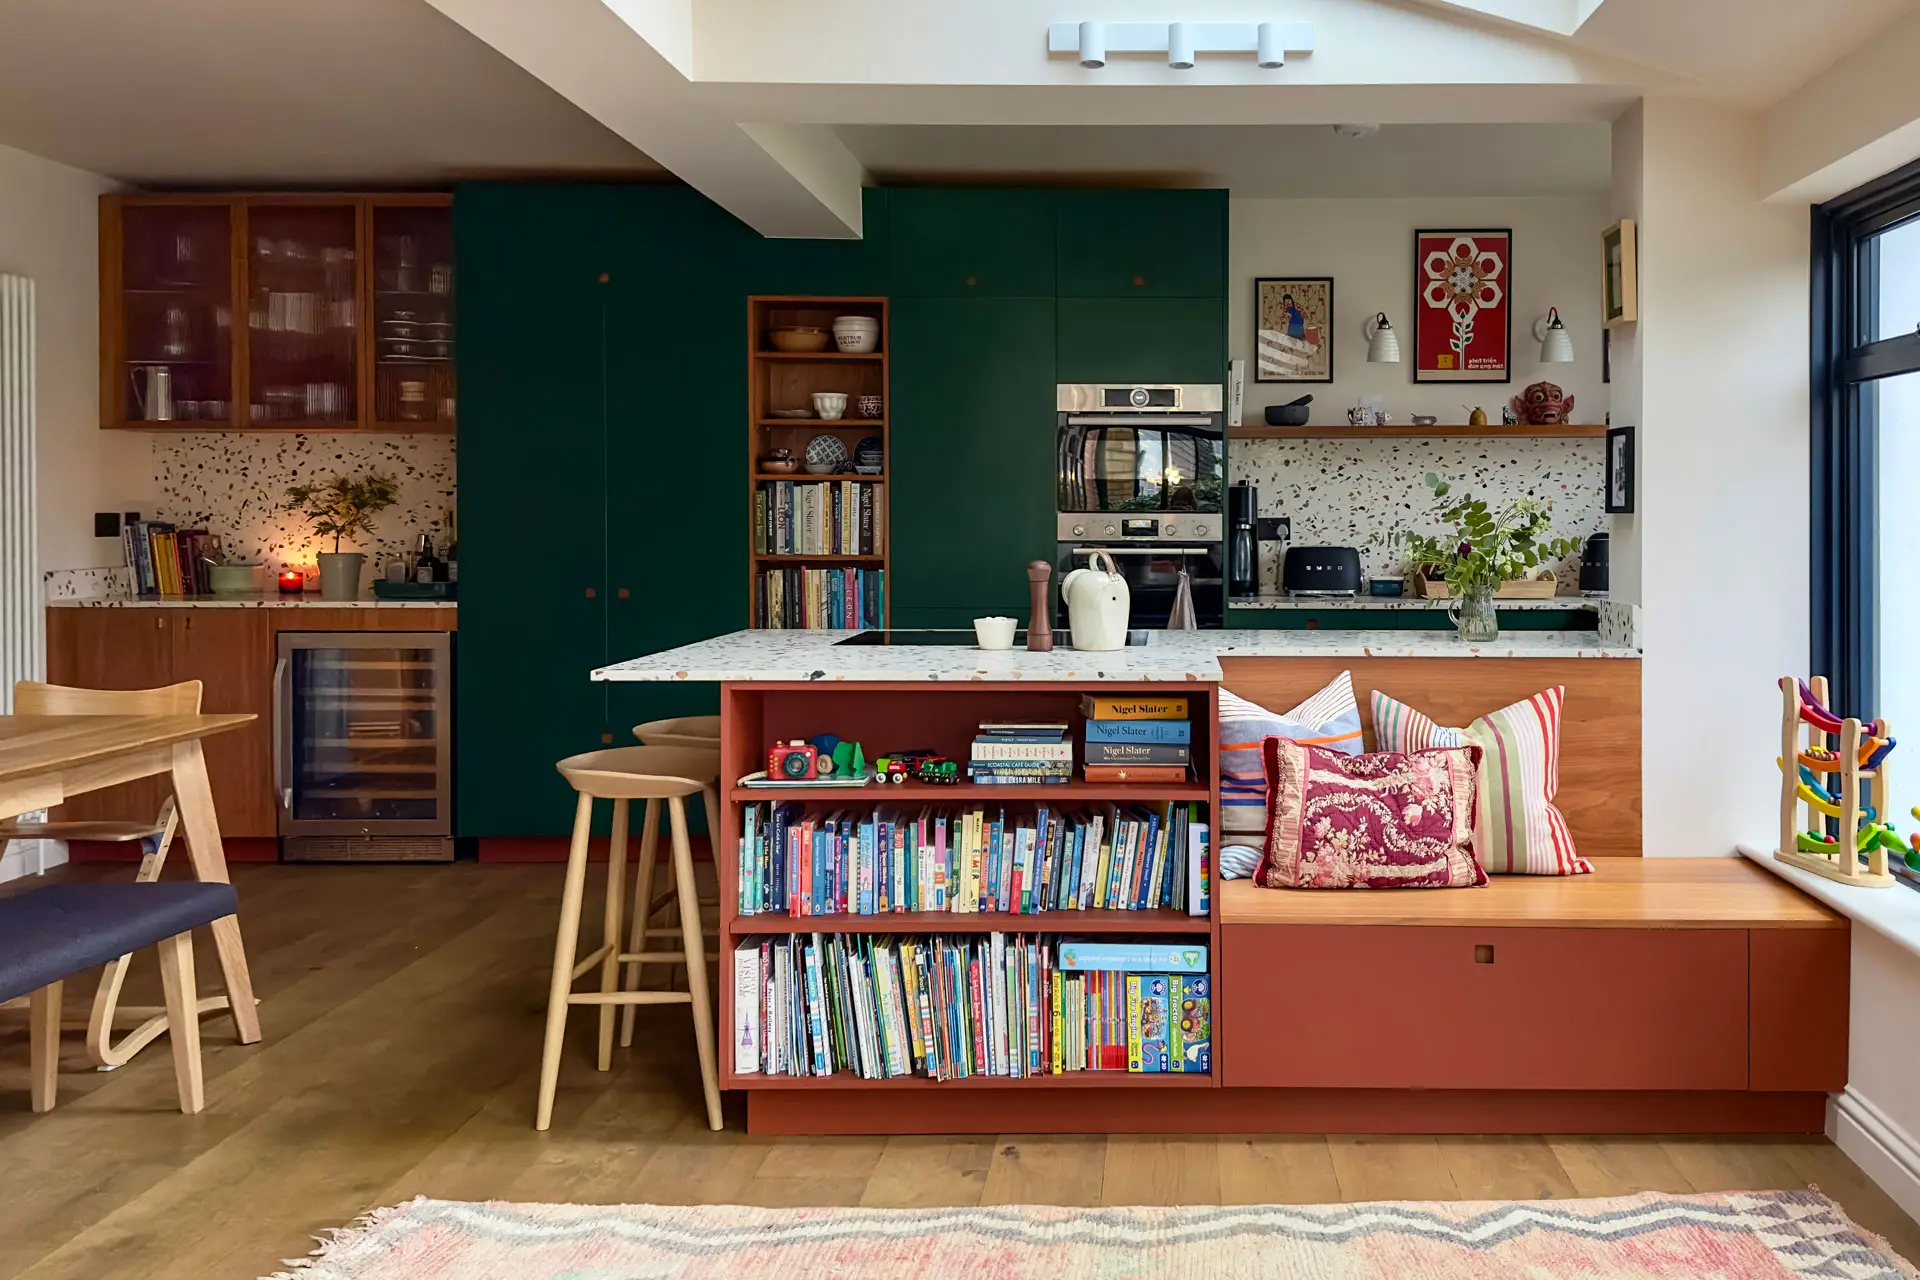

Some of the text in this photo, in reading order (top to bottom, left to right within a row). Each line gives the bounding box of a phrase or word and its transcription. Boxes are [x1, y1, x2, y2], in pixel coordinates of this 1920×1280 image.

[862, 488, 871, 529] Nigel Slater
[1112, 704, 1168, 715] Nigel Slater
[1097, 726, 1120, 737] Nigel
[1122, 726, 1146, 736] Slater
[1104, 746, 1151, 756] Nigel Slater
[972, 849, 981, 879] ELMER
[1129, 981, 1137, 994] Big
[1171, 980, 1179, 993] Big
[1129, 1013, 1137, 1039] Engine
